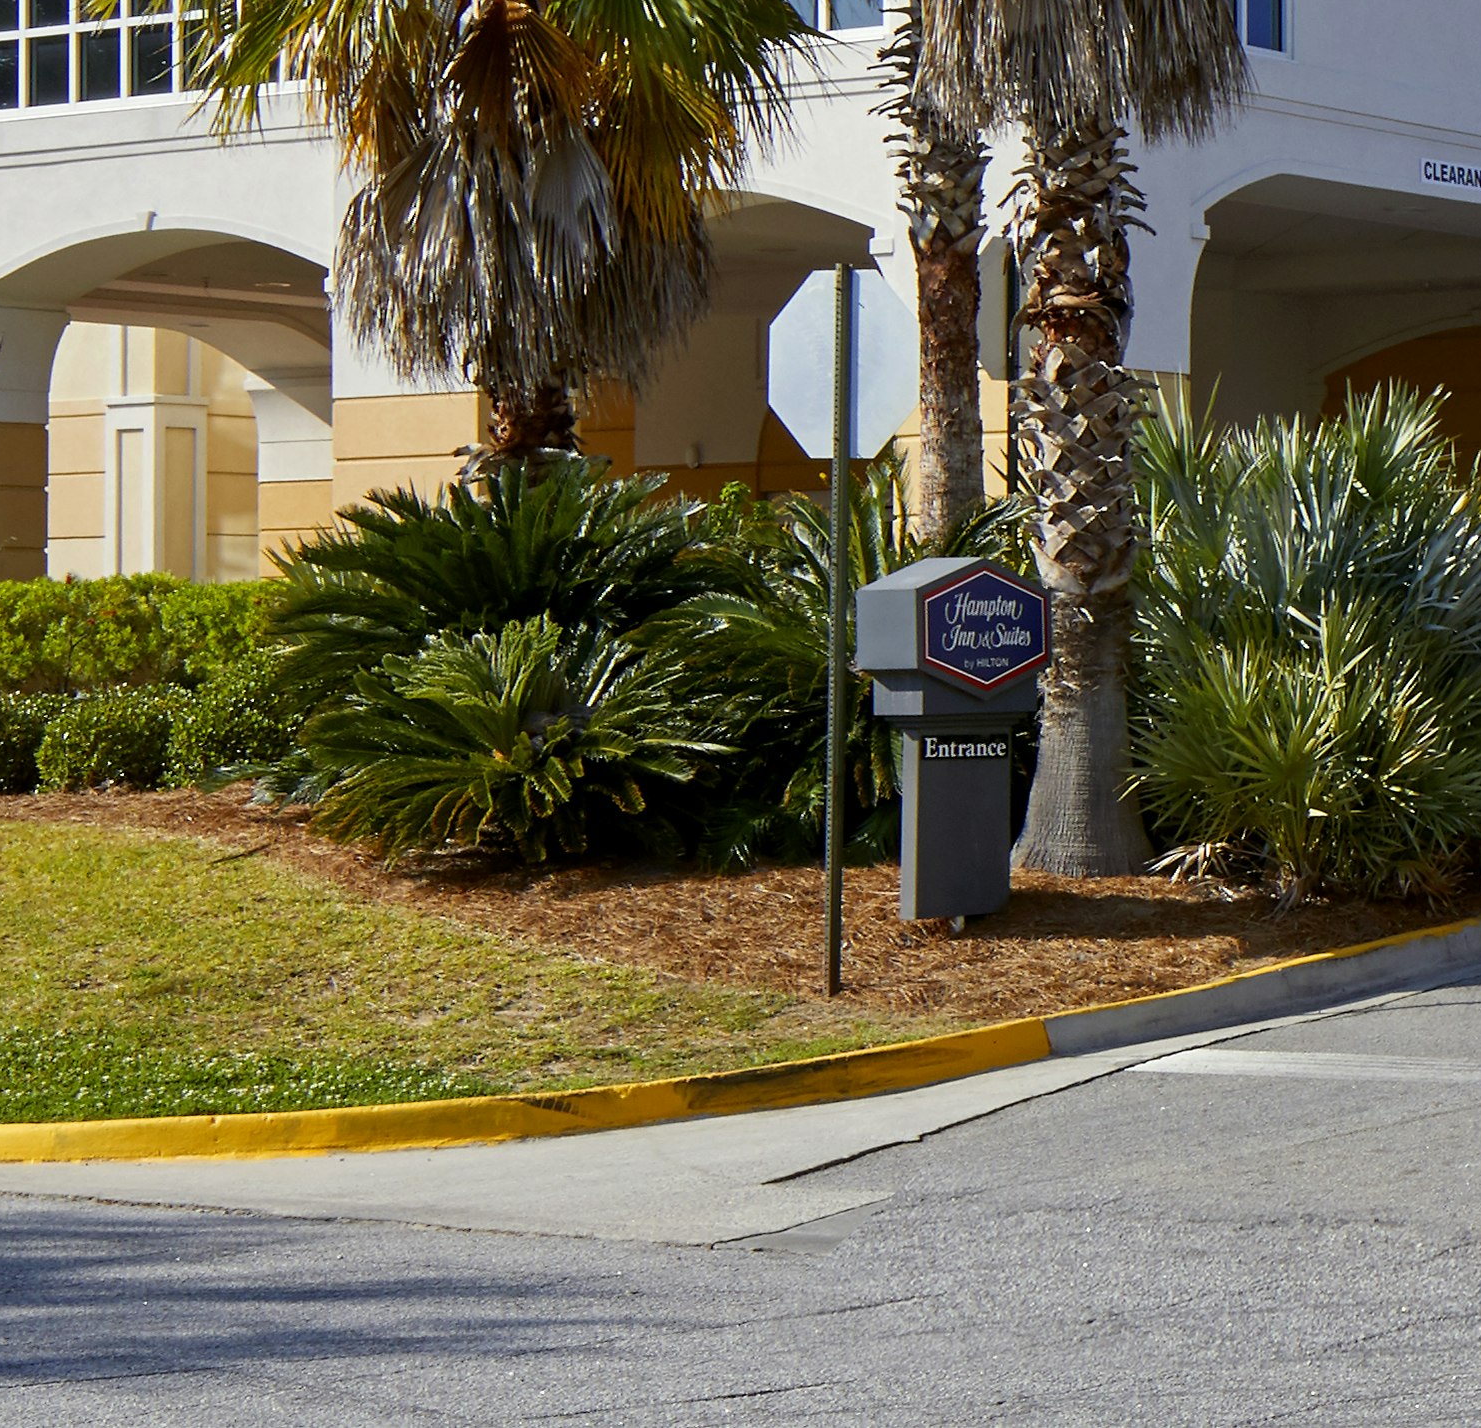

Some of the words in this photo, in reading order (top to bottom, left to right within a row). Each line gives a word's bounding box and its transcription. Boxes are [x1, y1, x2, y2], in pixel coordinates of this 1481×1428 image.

[945, 591, 1023, 624] Hampton
[942, 624, 981, 651] Inn
[982, 630, 992, 649] &
[990, 623, 1031, 647] Suites
[964, 658, 975, 670] by
[976, 658, 1009, 667] HILTON
[924, 737, 1007, 758] Entrance
